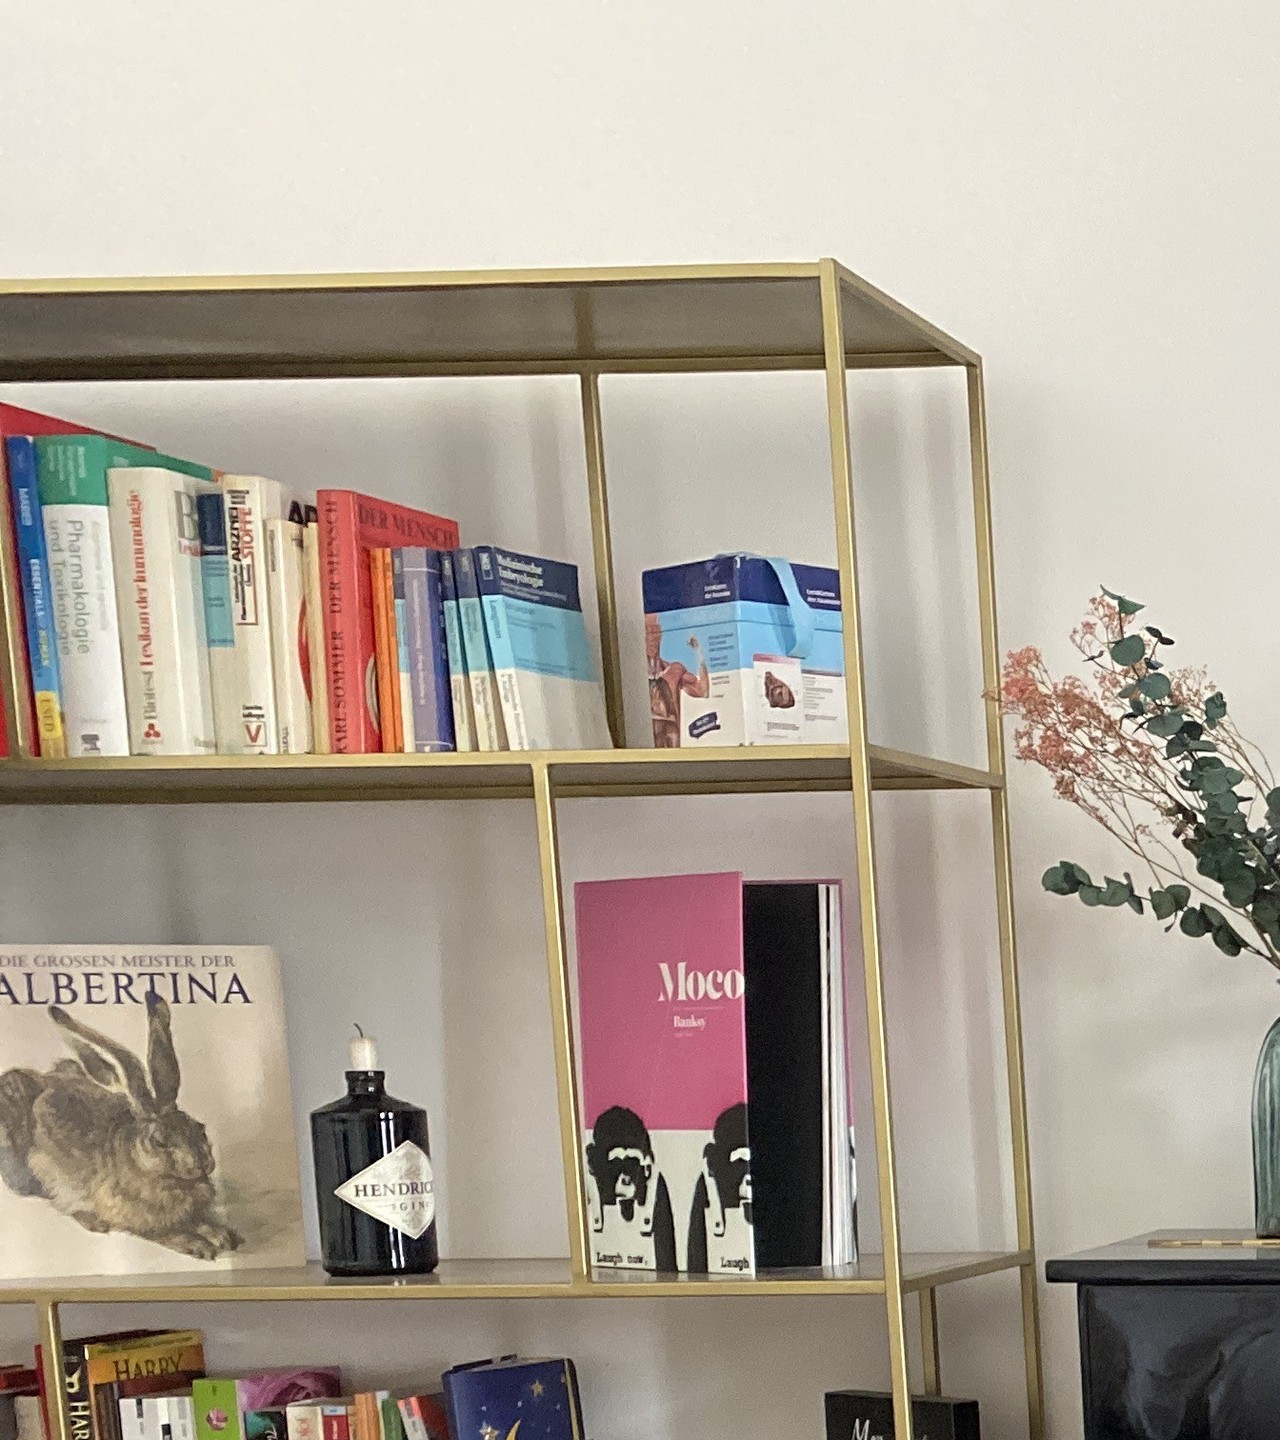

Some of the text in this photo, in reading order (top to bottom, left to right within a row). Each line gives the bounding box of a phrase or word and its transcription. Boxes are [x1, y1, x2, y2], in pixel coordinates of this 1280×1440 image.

[128, 488, 147, 586] Immunologie
[228, 505, 242, 562] ARZNEI
[239, 506, 254, 560] STOFFE
[325, 500, 341, 575] MENSCH
[359, 506, 456, 547] DER MENSCH
[49, 519, 71, 656] und Toxikologie
[66, 519, 90, 655] Pharmakologie
[135, 586, 148, 611] der
[329, 580, 343, 614] DER
[137, 613, 154, 666] Lexikon
[331, 630, 346, 709] SOMMER
[0, 955, 236, 968] DIE GROSSEN MEISTER DER
[657, 961, 745, 1002] Moco
[0, 971, 254, 1006] ALBERTINA
[673, 1014, 706, 1031] Banksy
[400, 1201, 425, 1211] GIN
[596, 1251, 623, 1266] Laugh
[720, 1256, 750, 1271] Laugh
[112, 1352, 184, 1381] HARRY
